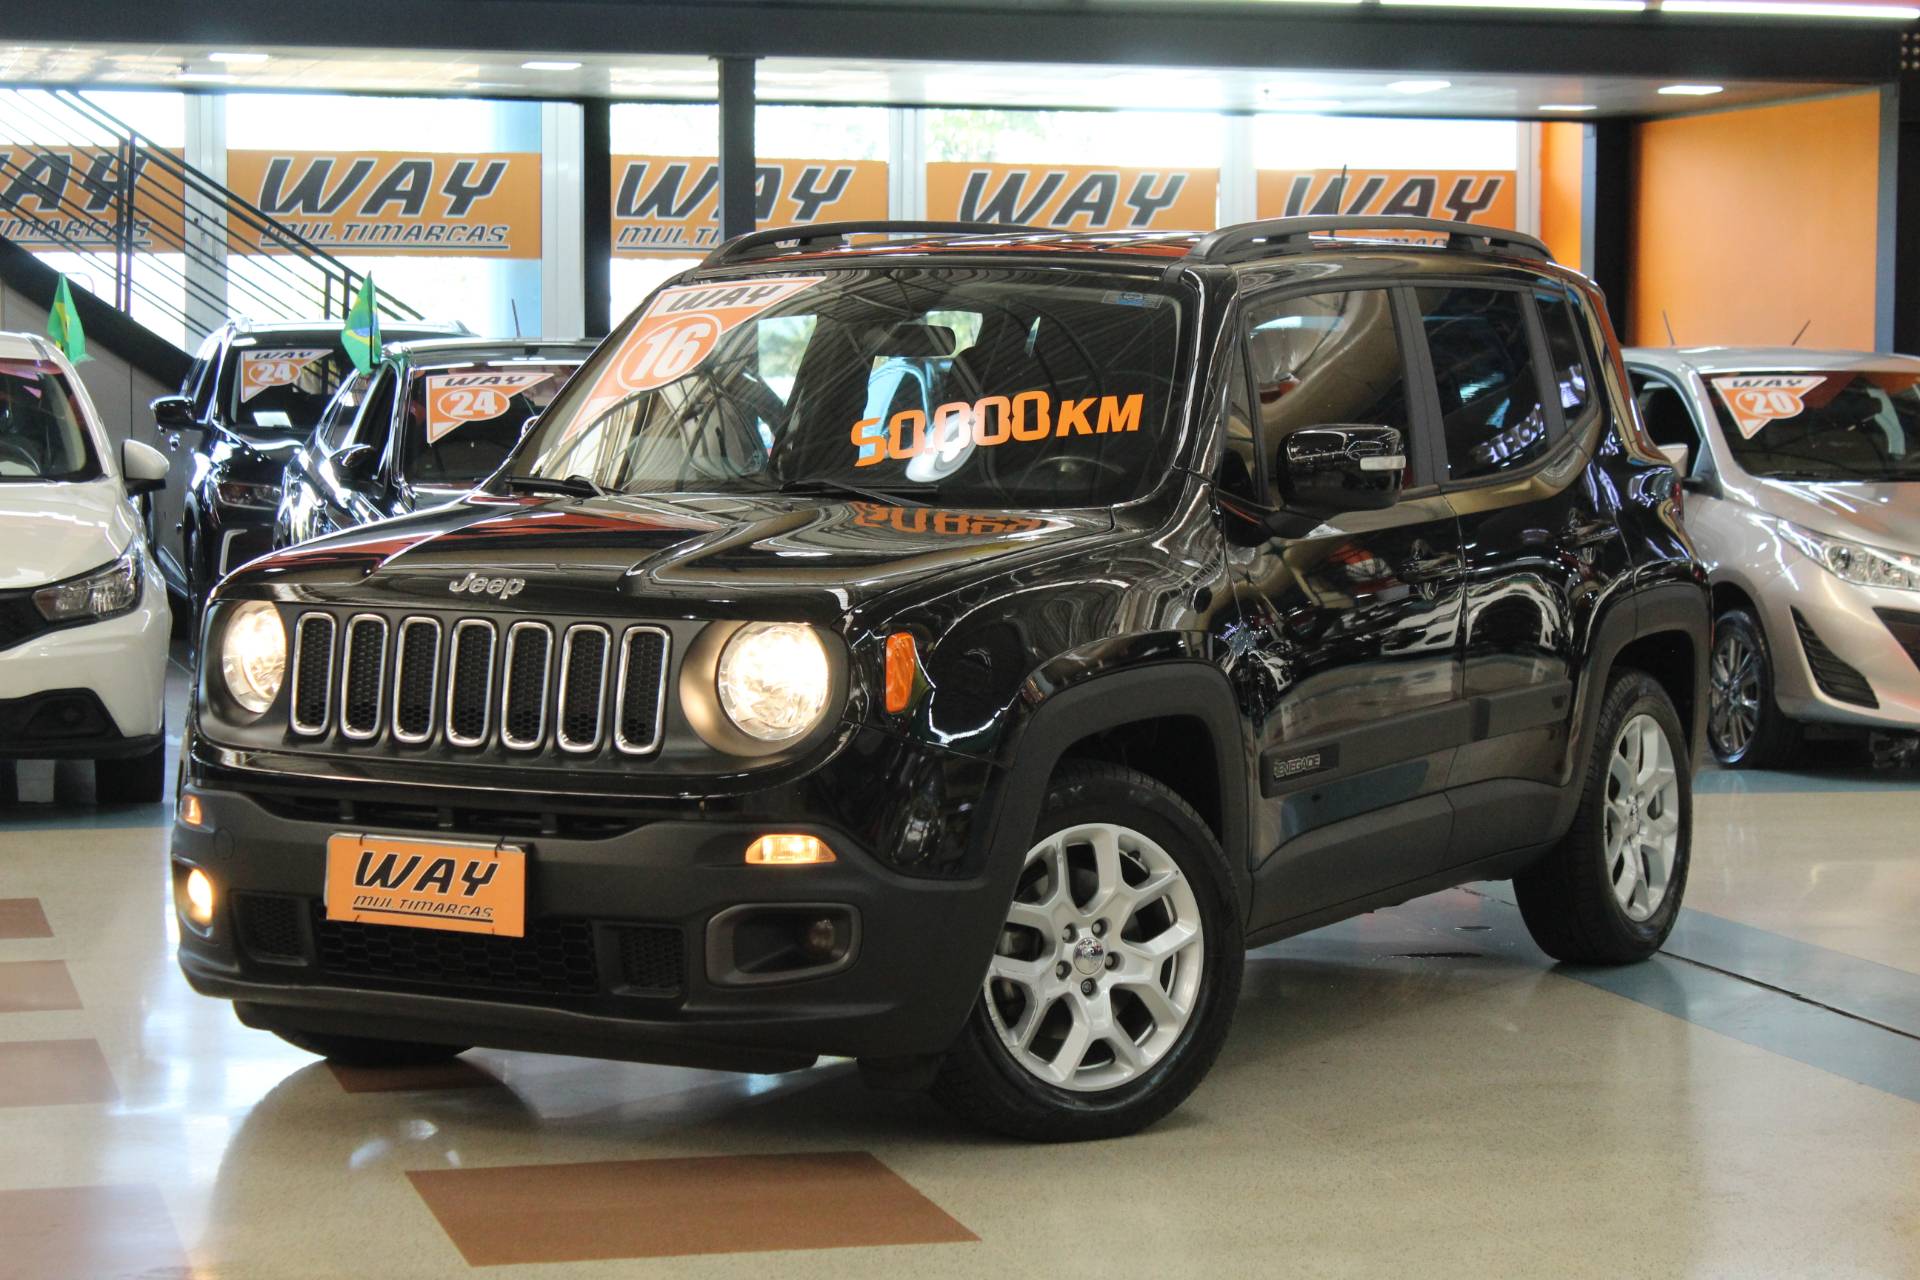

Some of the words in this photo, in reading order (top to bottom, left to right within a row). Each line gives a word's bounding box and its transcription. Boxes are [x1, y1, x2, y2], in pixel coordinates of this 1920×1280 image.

[0, 152, 149, 212] AY
[259, 157, 509, 217] WAY
[959, 170, 1189, 228] WAY
[1284, 175, 1504, 224] WAY
[665, 285, 782, 313] WAY
[254, 351, 313, 360] WAY
[629, 323, 711, 379] 16
[256, 363, 291, 381] 24
[444, 376, 526, 387] WAY
[1732, 379, 1802, 388] WAY
[449, 391, 497, 417] 24
[1744, 391, 1797, 415] 20
[448, 572, 526, 600] Jeep
[354, 851, 499, 897] WAY
